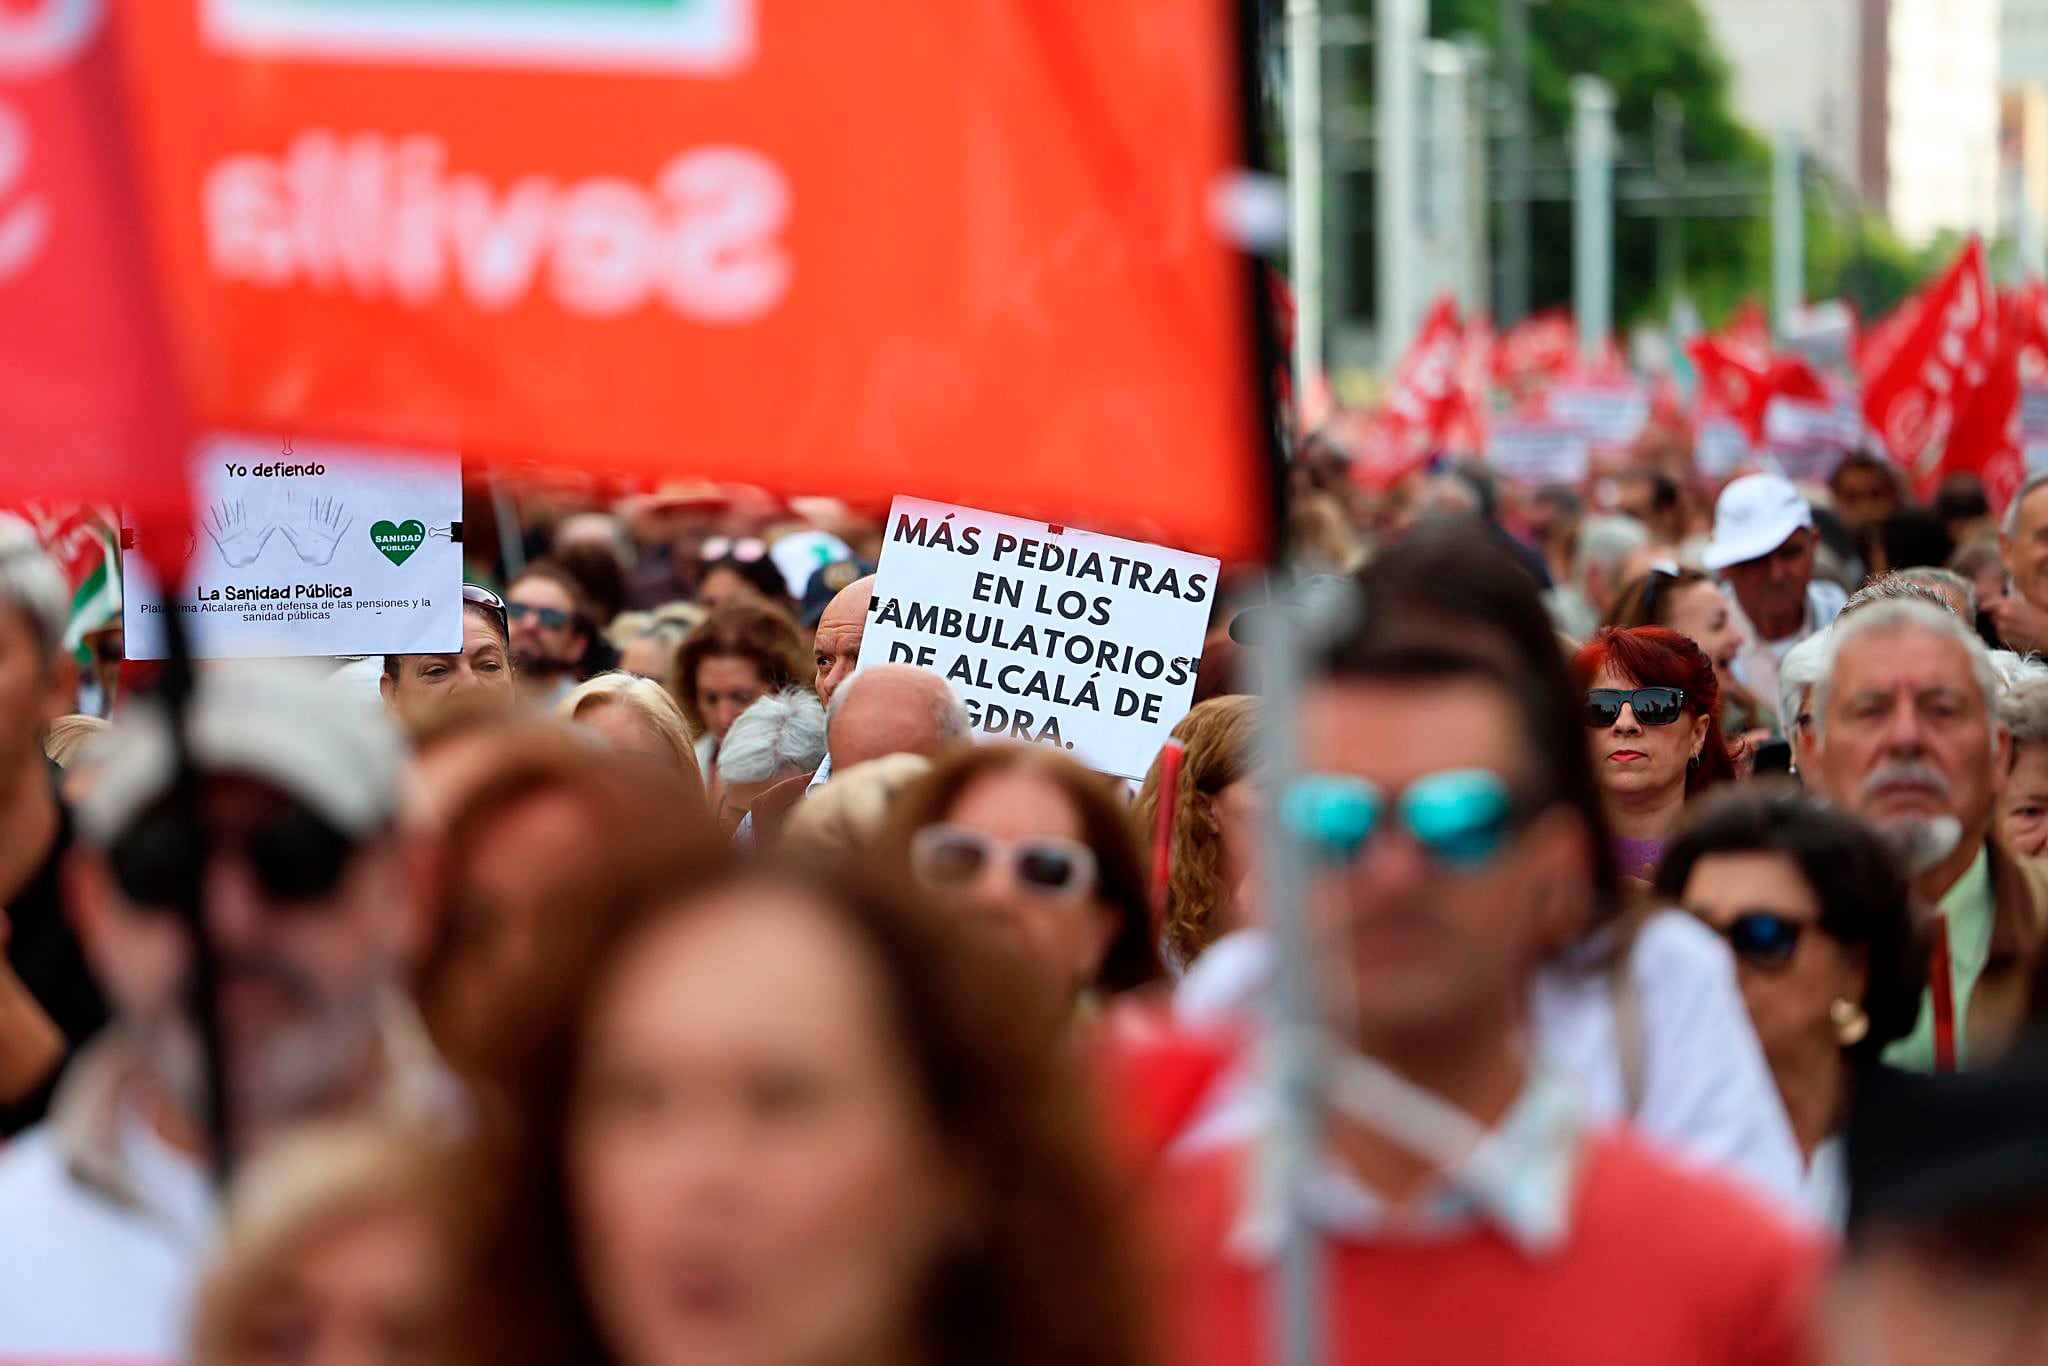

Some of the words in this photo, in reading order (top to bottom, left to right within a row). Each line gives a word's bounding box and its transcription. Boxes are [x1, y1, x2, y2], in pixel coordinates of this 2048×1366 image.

[225, 463, 247, 478] Yo
[252, 461, 325, 478] defiendo
[374, 534, 422, 544] SANIDAD
[380, 543, 416, 552] PÚBLICA
[893, 512, 982, 556] MÁS
[992, 532, 1208, 603] PEDIATRAS
[198, 586, 219, 600] La
[225, 585, 290, 600] Sanidad
[295, 584, 352, 598] Pública
[972, 571, 1025, 609] EN
[1035, 584, 1112, 626] LOS
[201, 602, 256, 612] Alcalareña
[277, 601, 318, 610] defensa
[322, 600, 334, 609] de
[338, 600, 352, 608] las
[356, 599, 409, 610] pensiones
[413, 600, 418, 608] y
[422, 598, 431, 607] la
[243, 612, 284, 621] sanidad
[288, 611, 330, 621] públicas
[875, 598, 1189, 685] AMBULATORIOS
[946, 653, 1101, 712] ALCALÁ
[1114, 687, 1163, 724] DE
[965, 699, 1074, 750] GDRA.
